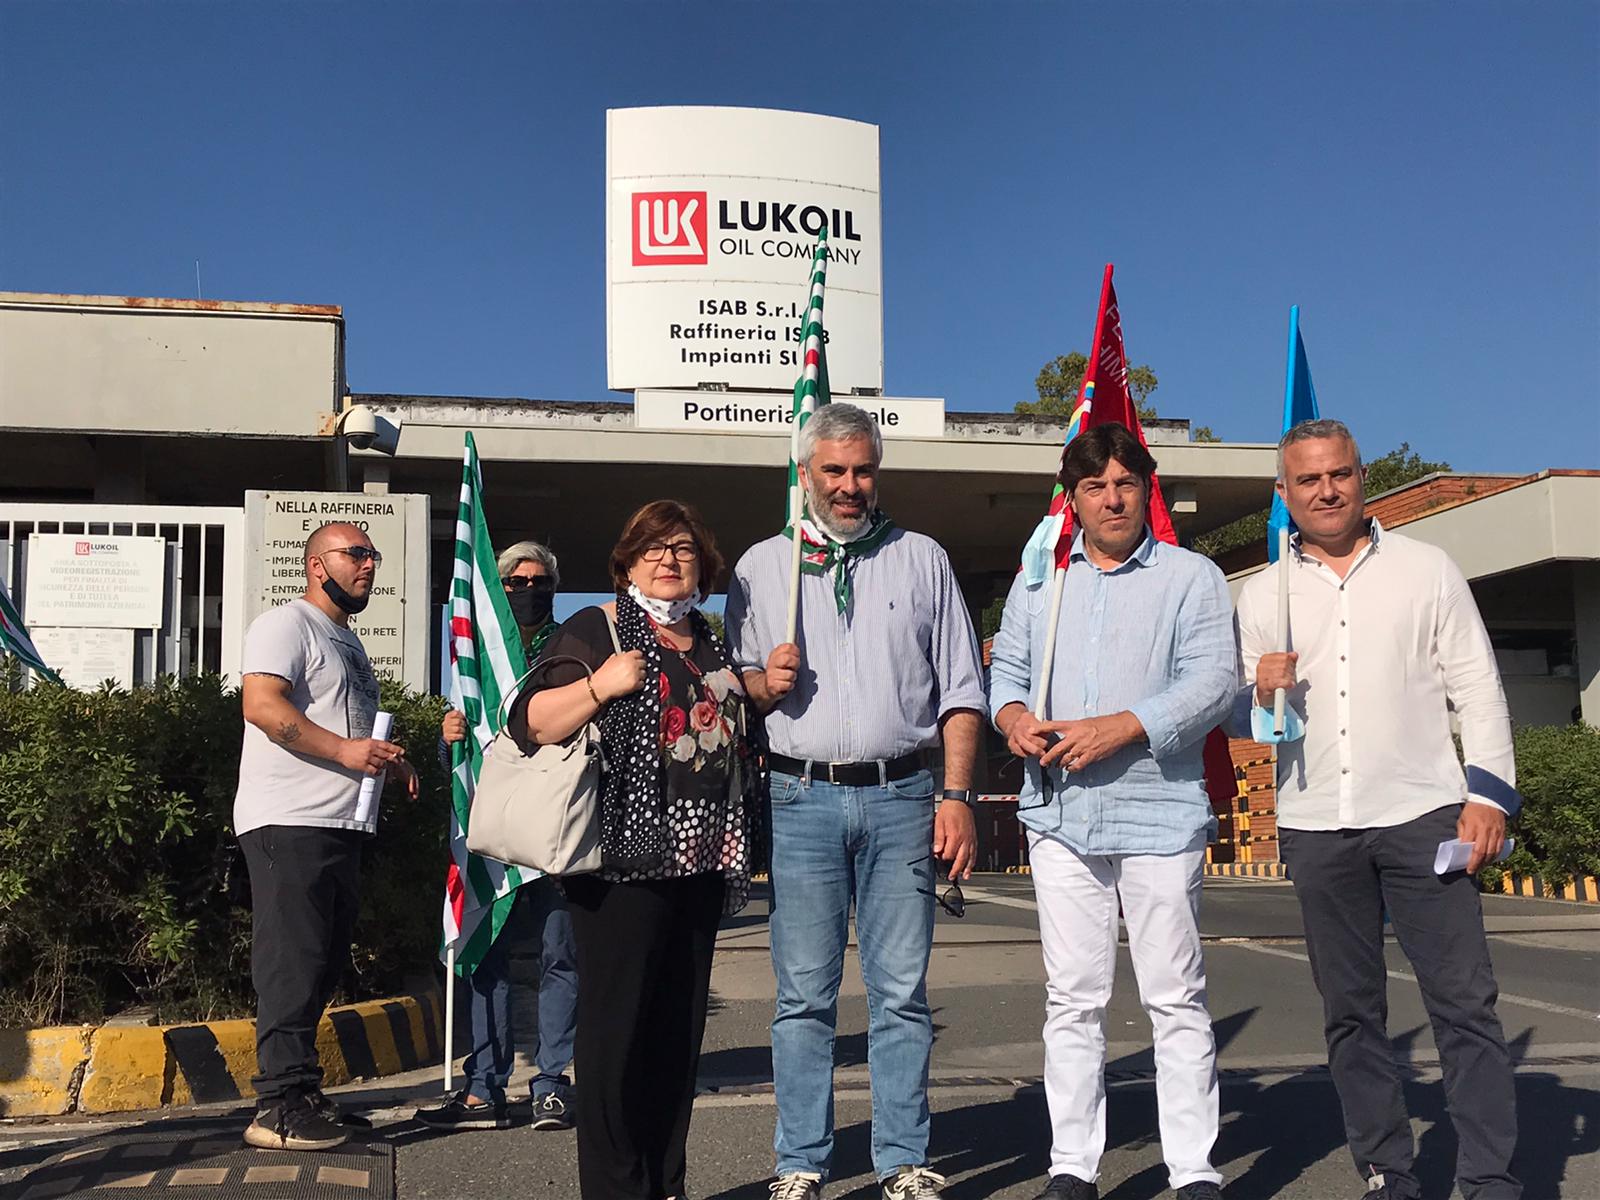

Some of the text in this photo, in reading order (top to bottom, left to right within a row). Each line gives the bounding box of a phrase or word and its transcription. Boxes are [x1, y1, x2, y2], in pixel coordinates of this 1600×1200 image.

[719, 200, 861, 241] LUKOIL
[720, 238, 754, 255] OIL
[699, 299, 802, 318] ISAB S.r.l.
[670, 323, 830, 344] Raffineria ISB
[681, 348, 771, 367] Impianti
[684, 402, 794, 424] Portineria
[276, 501, 394, 515] NELLA RAFFINERIA
[272, 540, 307, 548] FUMAR
[373, 628, 397, 636] RETE
